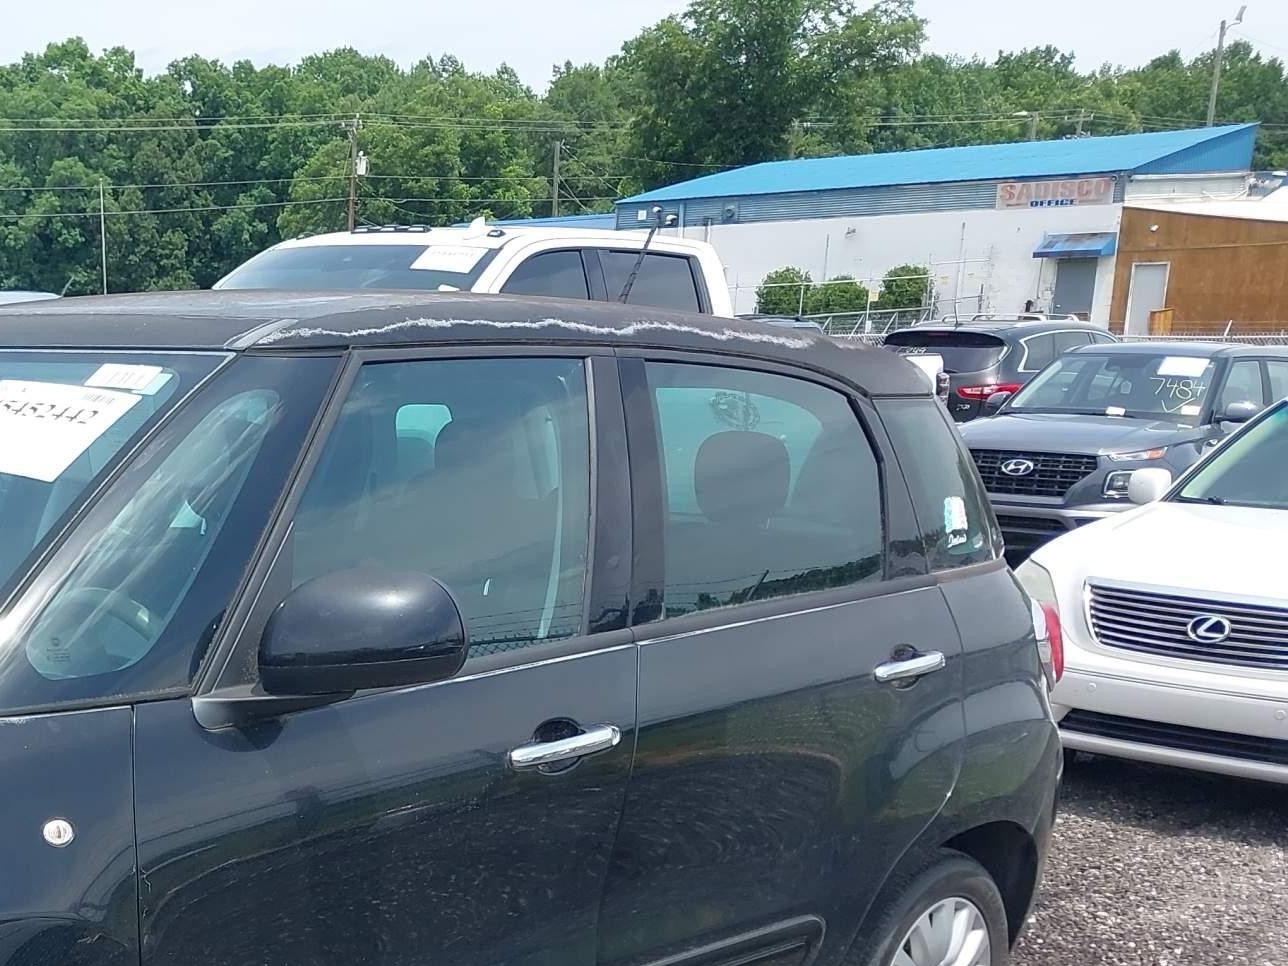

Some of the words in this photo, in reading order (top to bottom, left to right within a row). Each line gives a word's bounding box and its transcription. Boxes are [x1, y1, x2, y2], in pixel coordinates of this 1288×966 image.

[1000, 178, 1112, 201] SADISCO
[1030, 199, 1076, 208] OFFICE
[1149, 376, 1207, 400] 7484
